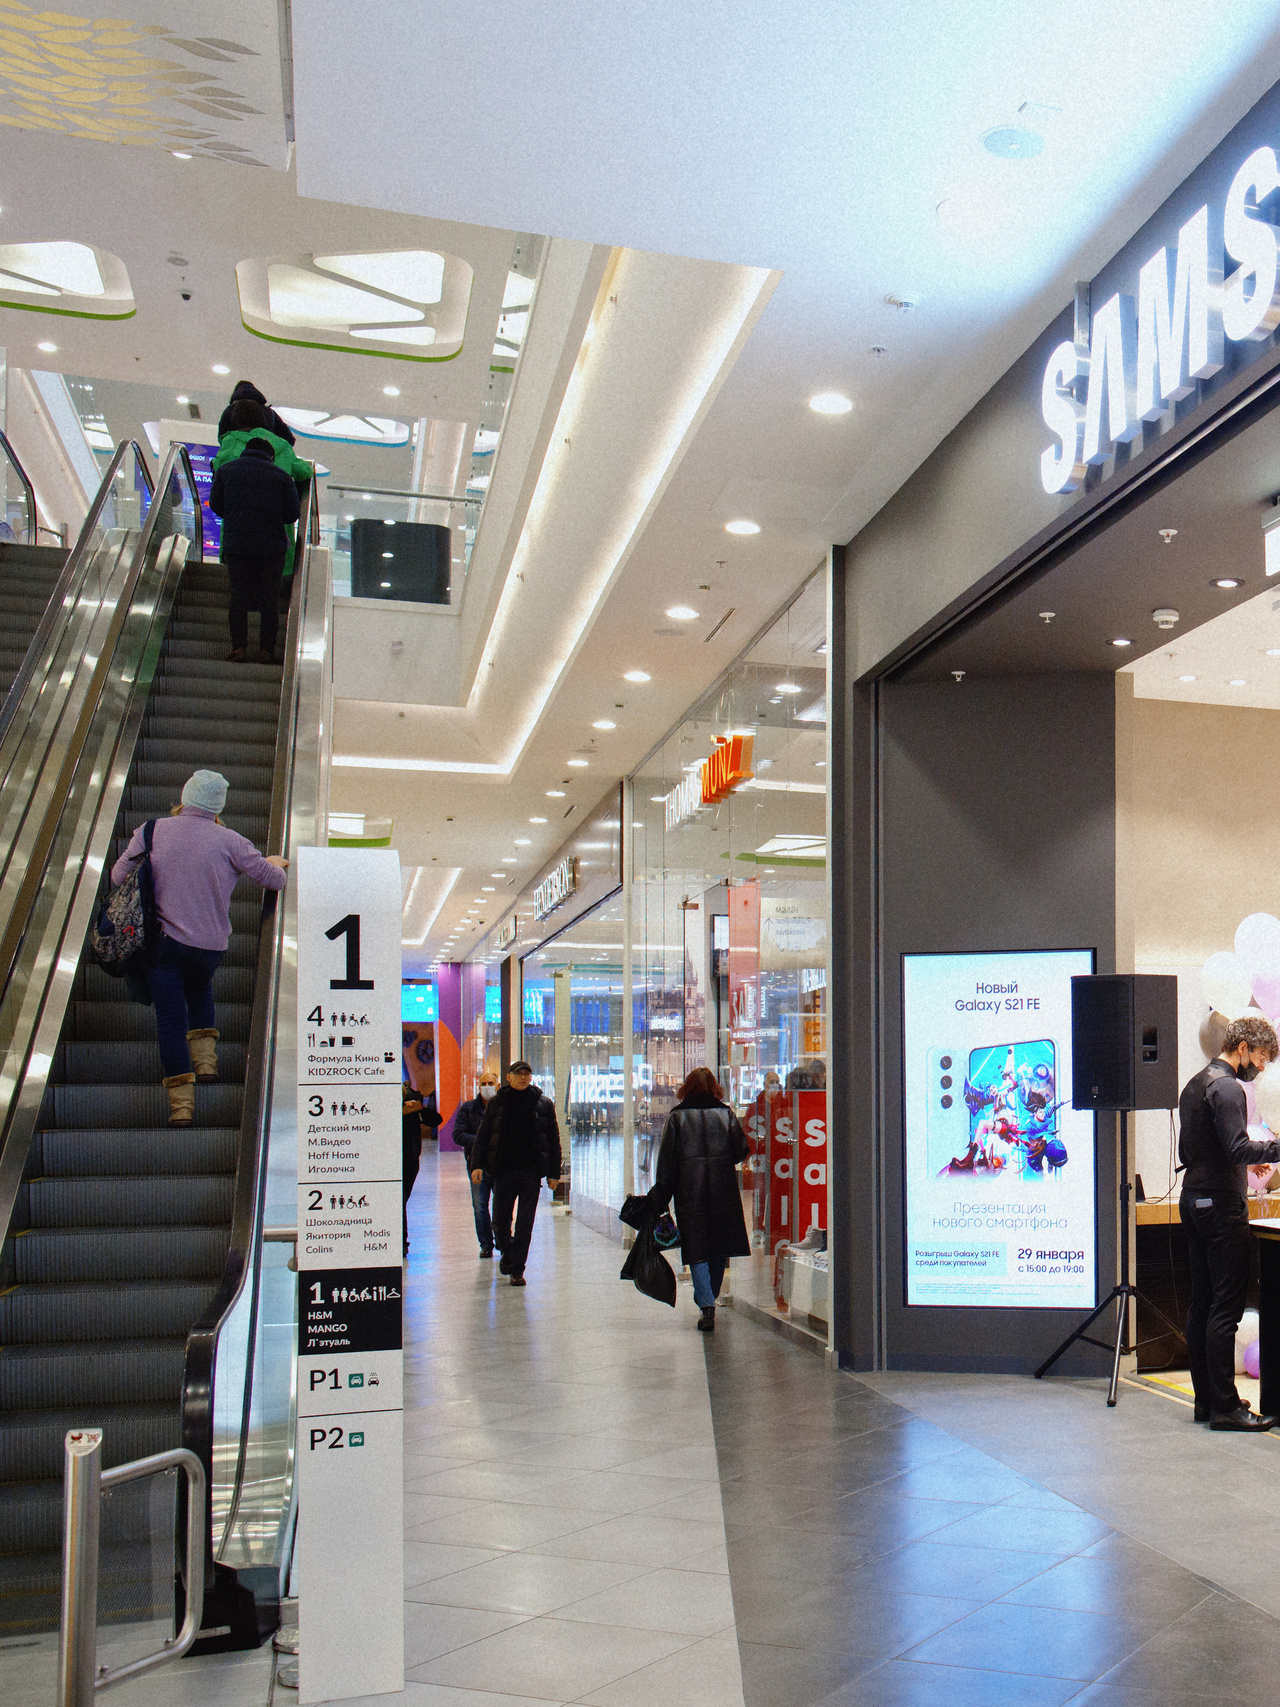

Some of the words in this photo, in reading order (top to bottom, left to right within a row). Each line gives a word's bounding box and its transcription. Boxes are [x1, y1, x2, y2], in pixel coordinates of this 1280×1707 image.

[324, 914, 375, 990] 1
[975, 980, 1019, 995] Новый
[954, 997, 1002, 1015] Galaxy
[1004, 998, 1025, 1011] S21
[1027, 998, 1041, 1011] FE
[307, 1005, 325, 1027] 4
[307, 1053, 353, 1064] Формула
[355, 1054, 380, 1063] Кино
[308, 1066, 362, 1077] KIDZROCK
[363, 1066, 385, 1076] Cafe
[308, 1095, 324, 1117] 3
[307, 1123, 350, 1134] Детский
[351, 1124, 371, 1133] мир
[308, 1138, 351, 1147] М.Видео
[308, 1151, 330, 1160] Hoff
[332, 1151, 360, 1160] Home
[308, 1165, 355, 1174] Иголочка
[307, 1190, 324, 1211] 2
[952, 1201, 1046, 1217] Презентация
[305, 1217, 373, 1227] Шоколадница
[932, 1217, 983, 1229] нового
[986, 1215, 1068, 1232] смартфона
[305, 1231, 351, 1240] Якитория
[363, 1228, 391, 1238] Modis
[305, 1244, 334, 1254] Colins
[363, 1242, 388, 1251] H&M
[915, 1249, 952, 1259] Розыгрыш
[953, 1250, 979, 1259] Galaxy
[980, 1250, 990, 1258] S21
[992, 1250, 1000, 1258] FE
[1018, 1248, 1033, 1259] 29
[1035, 1249, 1085, 1262] января
[940, 1259, 987, 1268] покупателей
[1026, 1265, 1047, 1273] 15:00
[1048, 1266, 1061, 1274] до
[1063, 1265, 1085, 1274] 19:00
[309, 1281, 325, 1305] 1
[307, 1310, 333, 1320] H&M
[307, 1323, 348, 1334] MANGO
[309, 1368, 343, 1392] P1
[309, 1426, 344, 1451] P2
